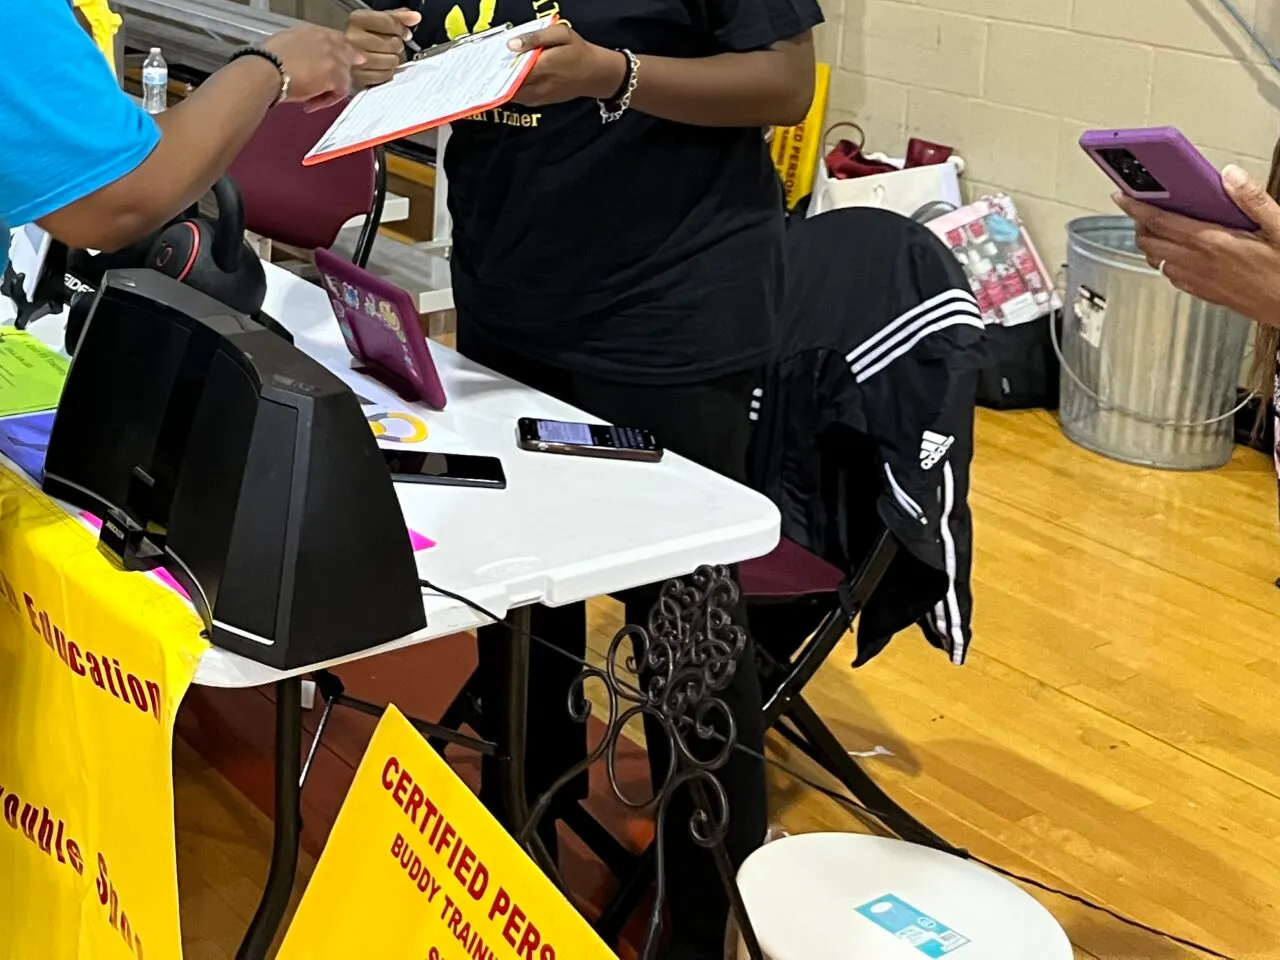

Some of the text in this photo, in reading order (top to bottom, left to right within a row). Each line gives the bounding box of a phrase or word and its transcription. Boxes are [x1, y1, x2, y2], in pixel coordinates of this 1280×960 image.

[23, 591, 161, 724] Education
[382, 757, 489, 901] CERTIFIED
[390, 832, 441, 903] BUDDY
